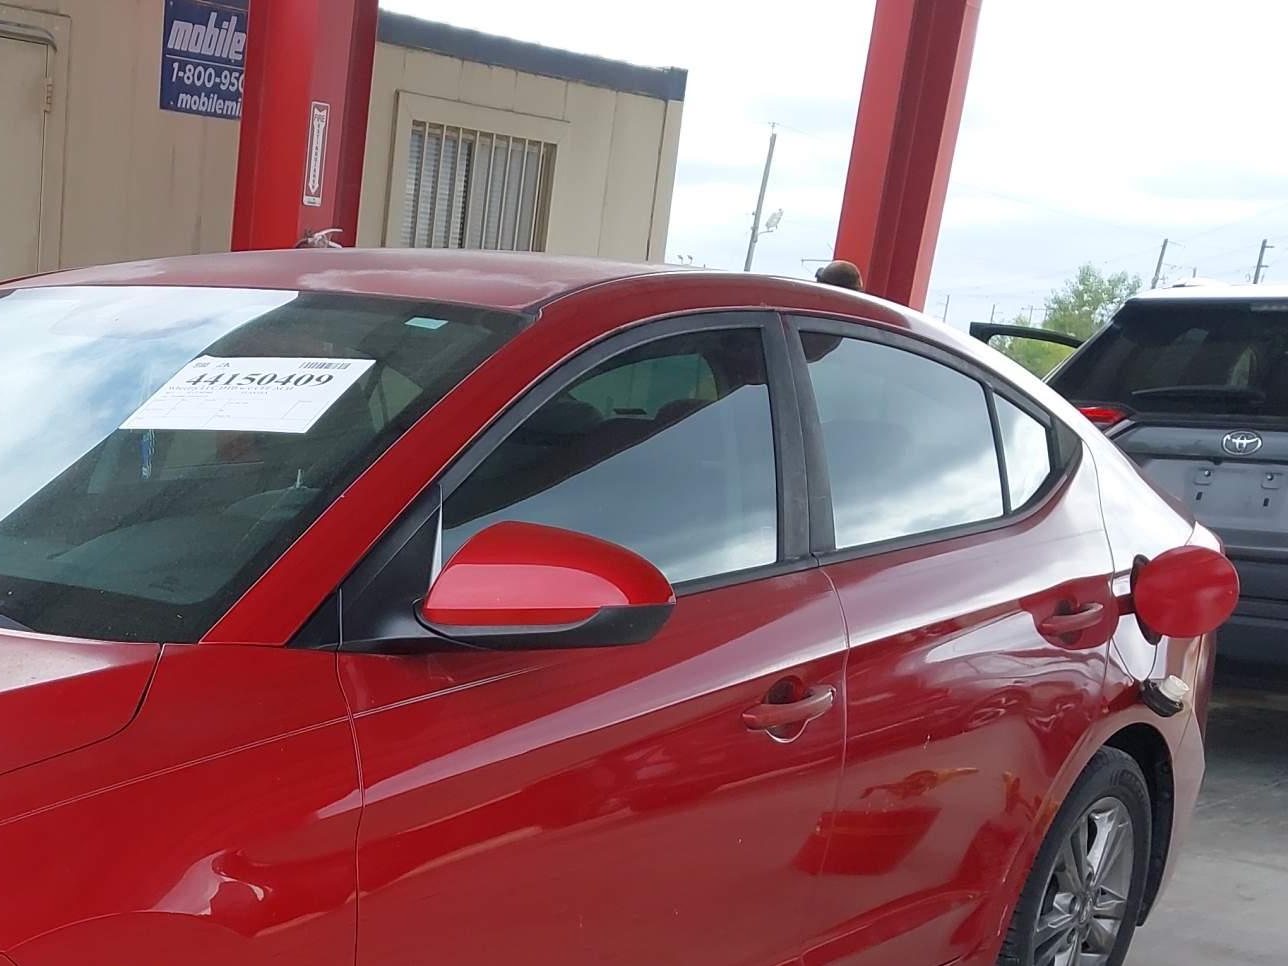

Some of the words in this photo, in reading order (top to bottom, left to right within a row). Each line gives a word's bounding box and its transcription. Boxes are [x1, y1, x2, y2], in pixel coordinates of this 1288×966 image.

[167, 11, 247, 60] mobile
[177, 92, 242, 117] mobilemi
[186, 372, 334, 387] 44150409
